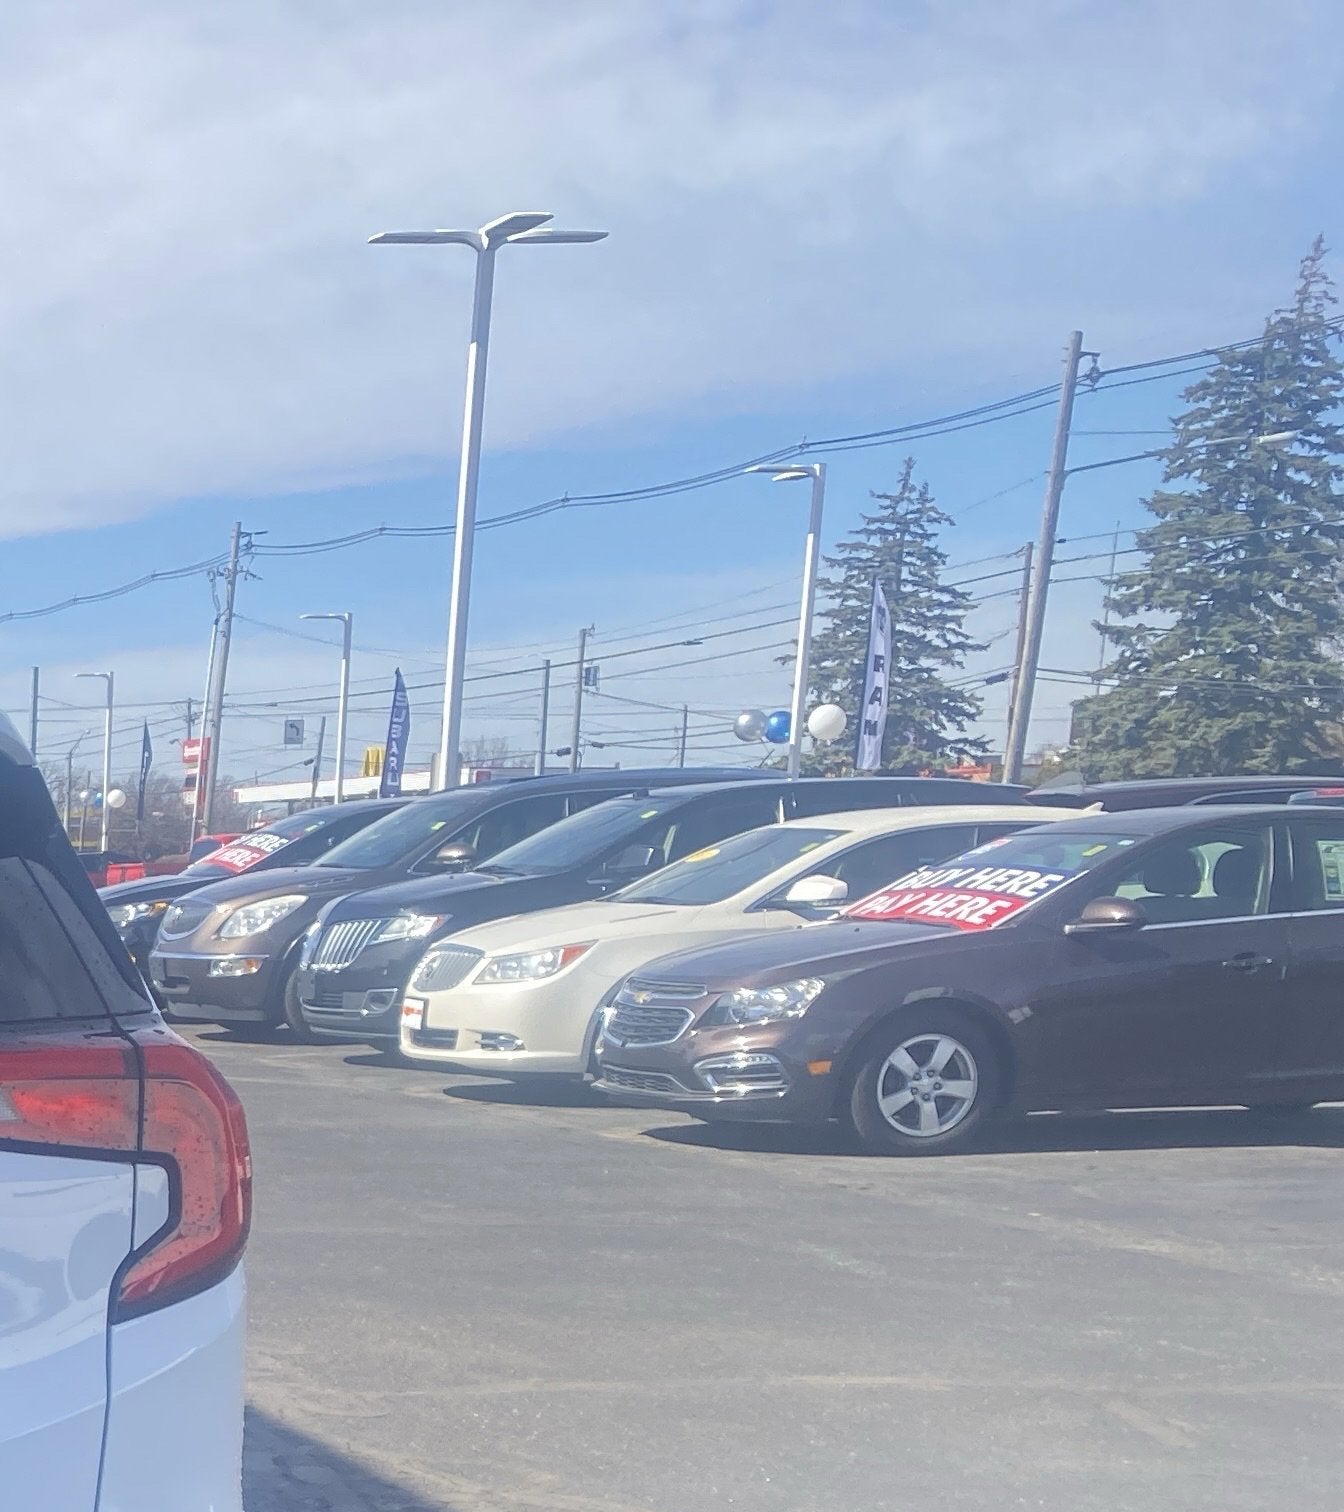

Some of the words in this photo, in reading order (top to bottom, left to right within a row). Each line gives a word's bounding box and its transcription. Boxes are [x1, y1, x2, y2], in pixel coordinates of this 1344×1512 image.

[863, 654, 885, 737] RAM
[386, 691, 409, 787] SUBARU
[851, 892, 927, 915] PAY
[905, 892, 1013, 925] HERE
[892, 867, 976, 890] BUY
[953, 867, 1065, 897] HERE
